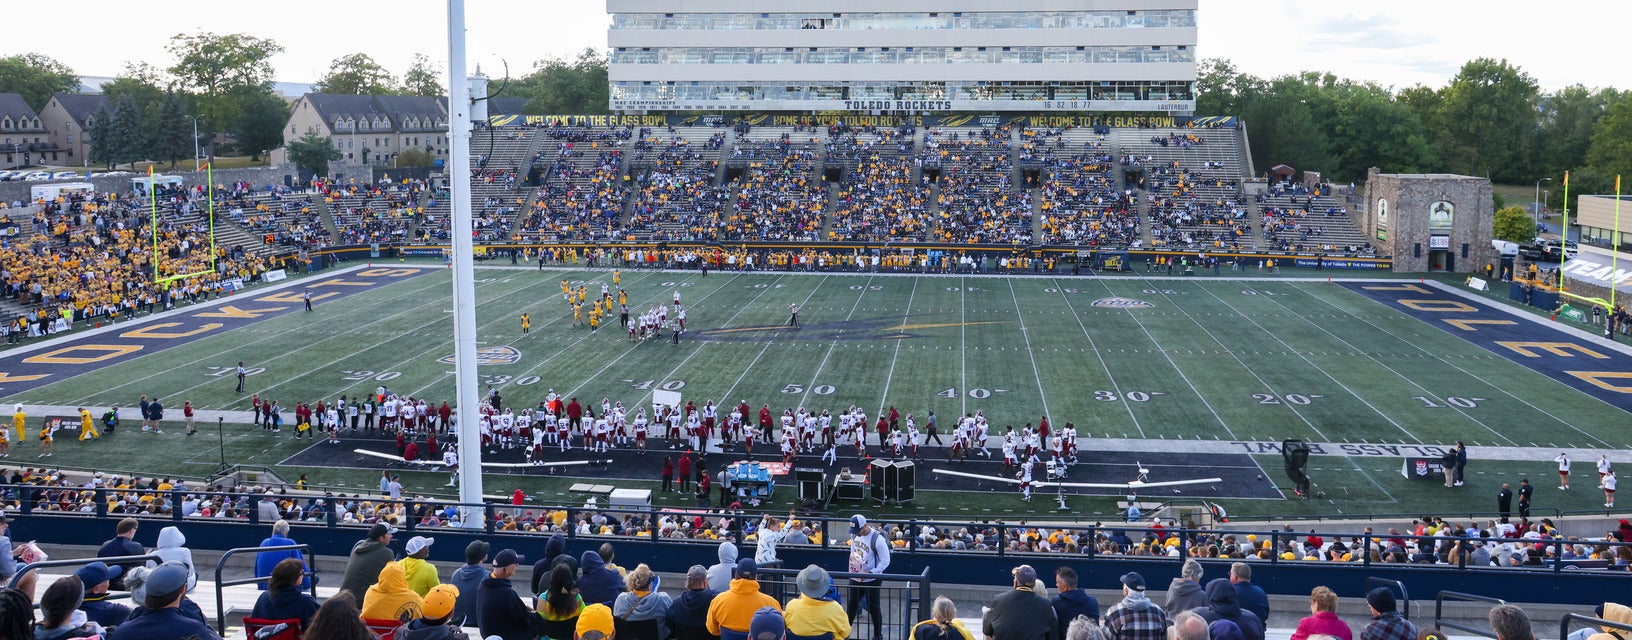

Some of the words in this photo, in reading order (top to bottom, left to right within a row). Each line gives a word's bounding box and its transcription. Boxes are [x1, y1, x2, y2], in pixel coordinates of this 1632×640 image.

[844, 101, 890, 110] TOLEDO
[896, 101, 952, 110] ROCKETS
[574, 115, 586, 126] TO
[589, 115, 606, 126] THE
[609, 115, 639, 126] GLASS
[642, 115, 668, 126] BOWL
[773, 116, 798, 126] HOME
[845, 116, 877, 126] TOLEDO
[1030, 117, 1075, 126] WELCOME
[1079, 117, 1090, 126] TO
[266, 234, 274, 244] 29
[485, 374, 542, 386] 30
[632, 380, 686, 390] 40
[780, 384, 837, 395] 50
[936, 387, 991, 399] 40
[1094, 390, 1150, 402] 30
[1252, 393, 1312, 405] 20
[1410, 396, 1478, 408] 10
